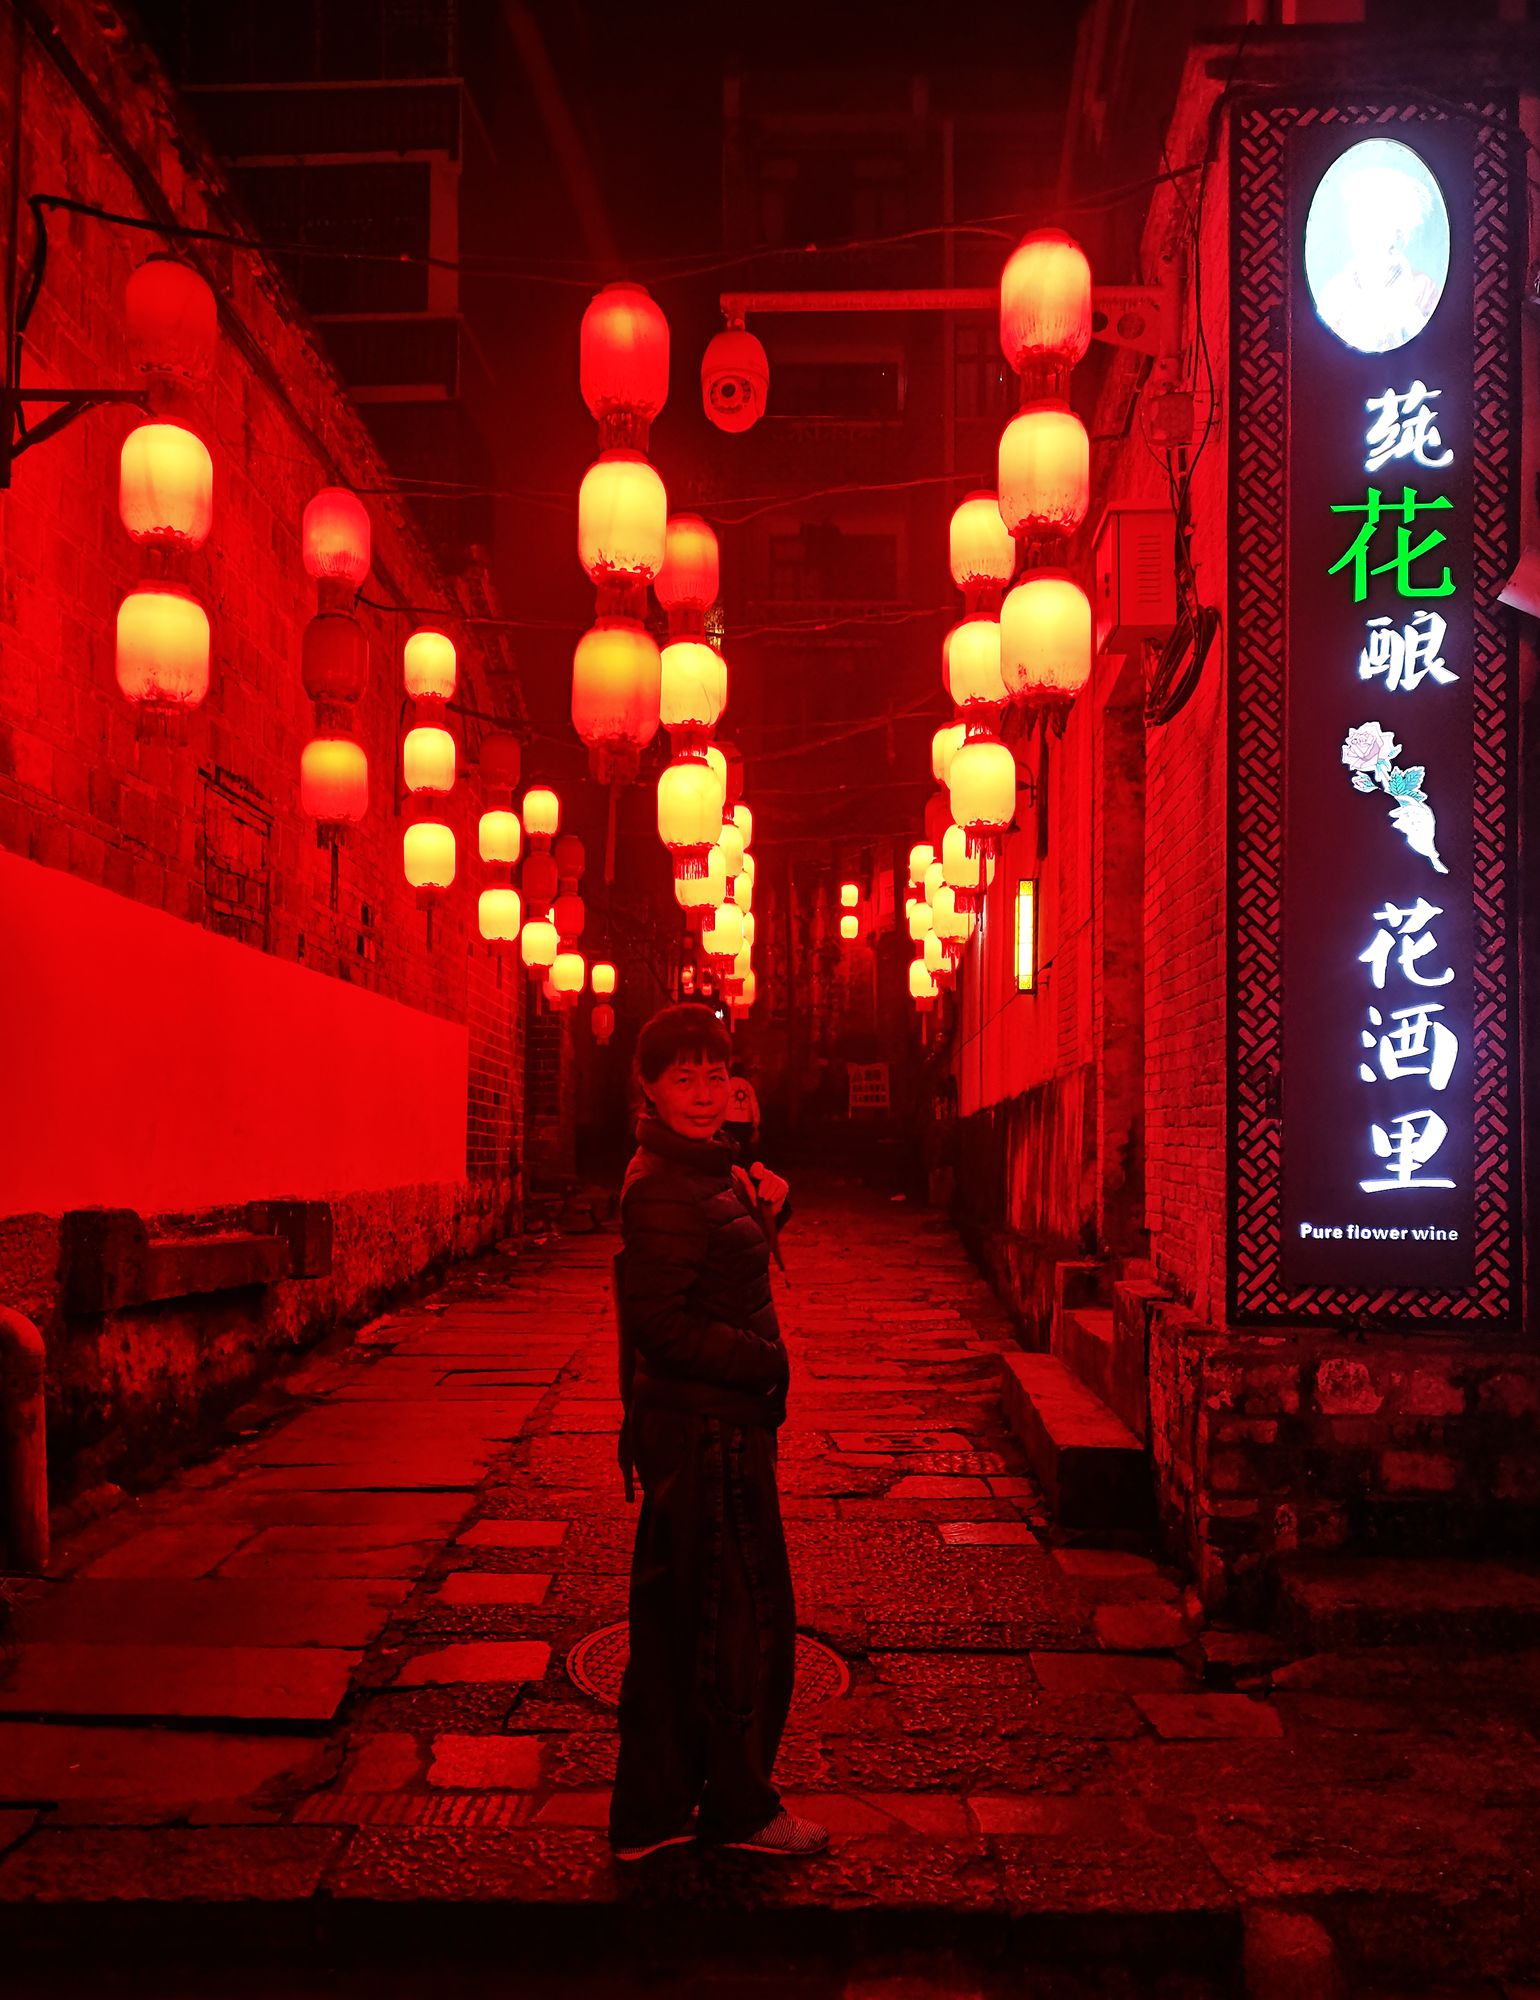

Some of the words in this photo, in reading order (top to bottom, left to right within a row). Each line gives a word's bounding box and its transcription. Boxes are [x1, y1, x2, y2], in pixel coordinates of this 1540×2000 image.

[1358, 896, 1459, 1194] 花酒里
[1300, 1222, 1343, 1239] Pure
[1346, 1224, 1408, 1240] flower
[1411, 1225, 1459, 1241] wine
